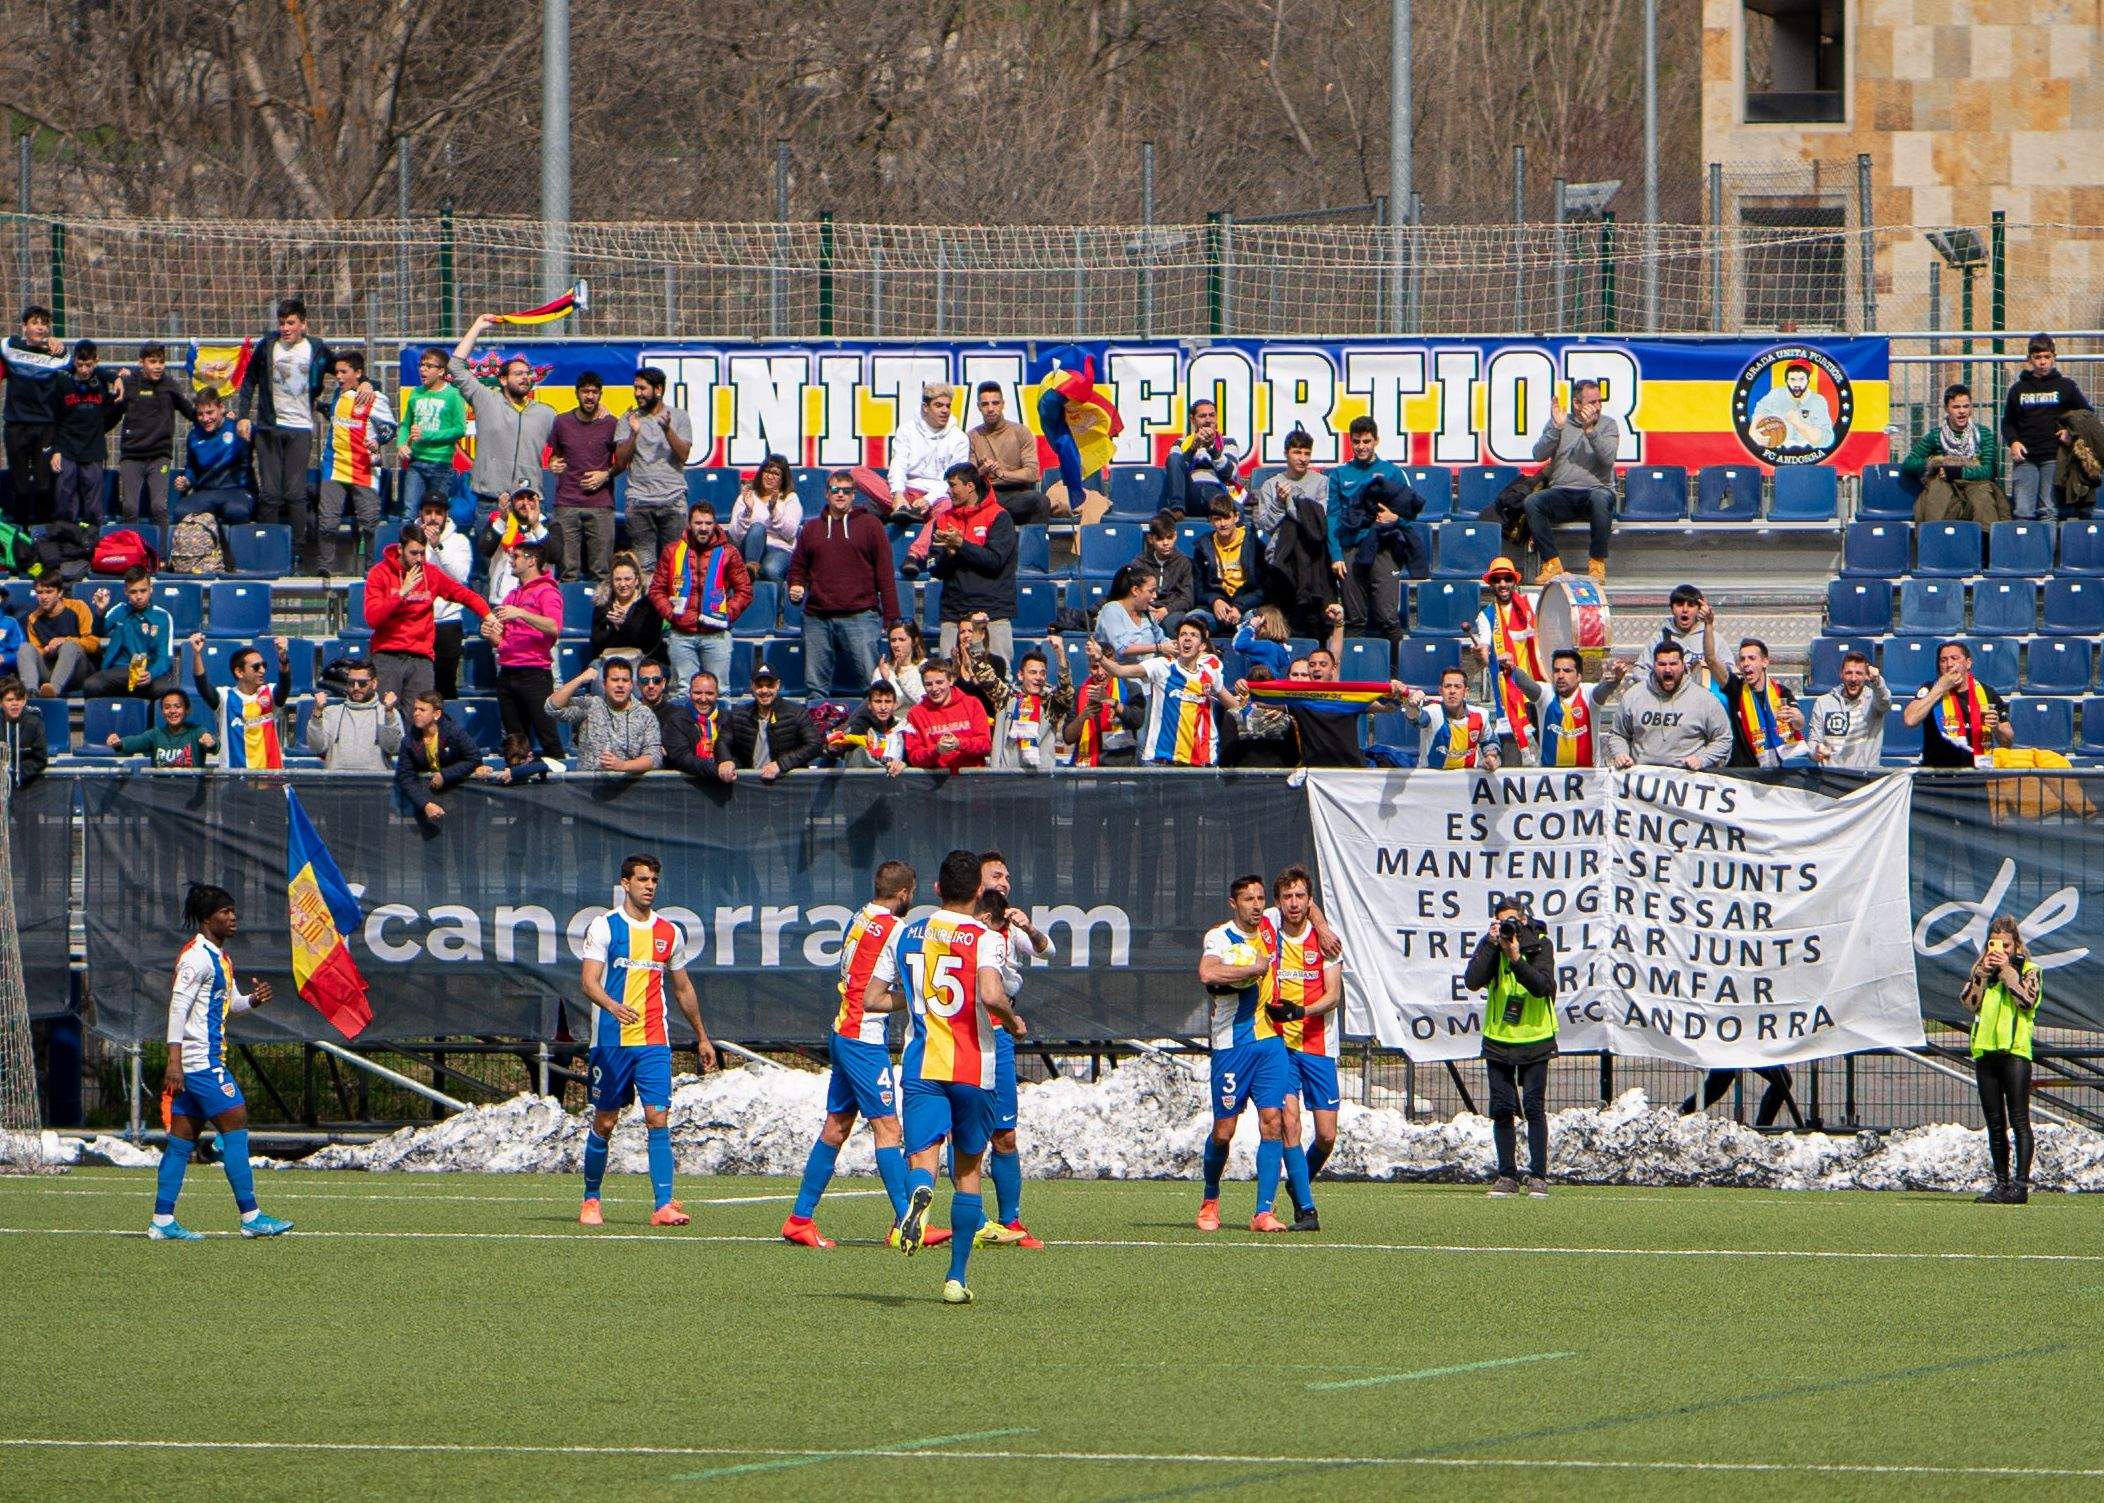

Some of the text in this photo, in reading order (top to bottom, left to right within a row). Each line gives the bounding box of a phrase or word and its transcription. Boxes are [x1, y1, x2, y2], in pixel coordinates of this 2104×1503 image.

[1108, 350, 1641, 466] FORTIOR
[1762, 449, 1826, 464] FC ANDORRA
[1641, 711, 1683, 727] OBEY
[1471, 773, 1737, 814] ANAR JUNTS
[1446, 808, 1747, 853] ES COMENÇAR
[1692, 860, 1818, 893] JUNTS
[1418, 885, 1774, 930] ES PROGRESSAR
[1397, 923, 1821, 967] TRELLAR JUNTS
[905, 952, 965, 1018] 15
[1452, 962, 1774, 1004] E RIOMFAR
[1396, 1011, 1482, 1040] OM
[1624, 1000, 1835, 1043] ANDORRA
[211, 1066, 225, 1084] 7
[591, 1065, 603, 1085] 9
[876, 1066, 893, 1089] 4
[1222, 1072, 1237, 1093] 3
